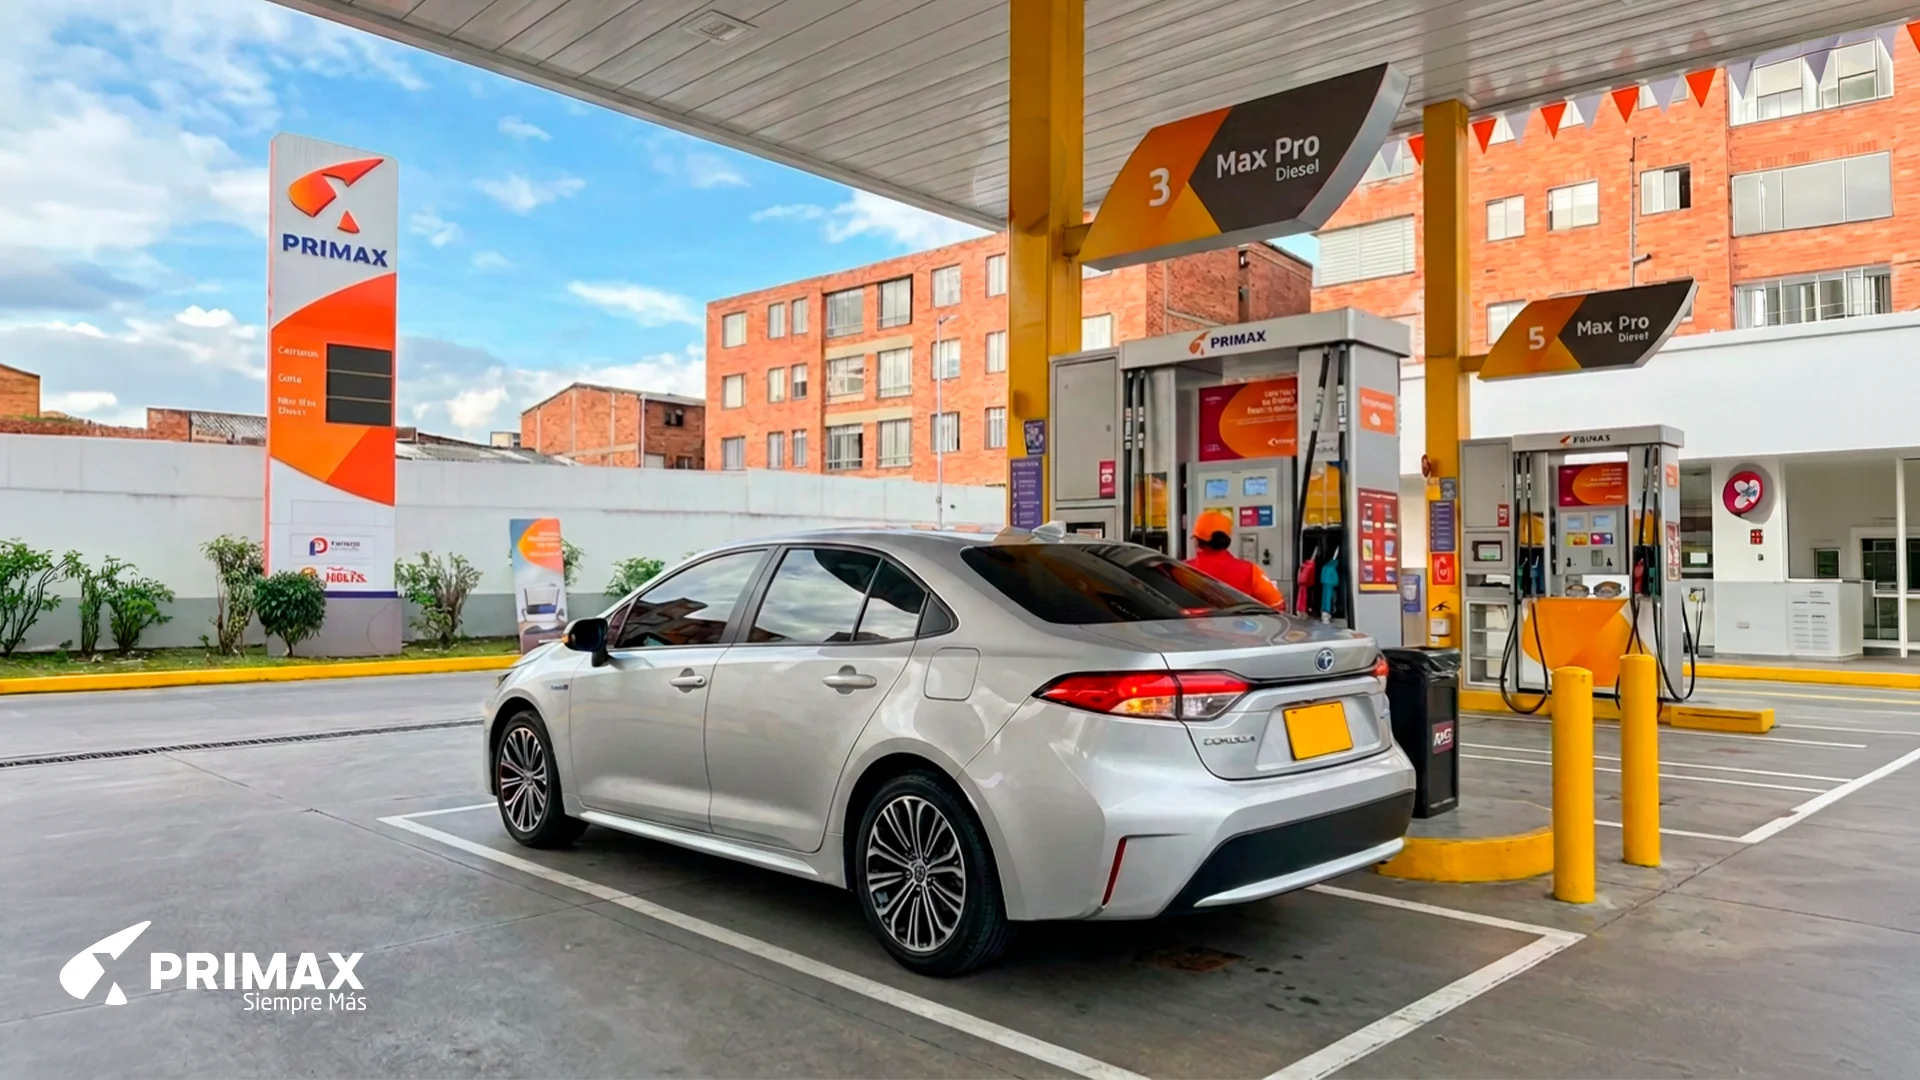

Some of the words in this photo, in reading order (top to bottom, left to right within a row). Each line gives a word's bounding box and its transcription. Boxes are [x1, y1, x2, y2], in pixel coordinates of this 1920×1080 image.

[1216, 148, 1268, 179] Max
[1275, 135, 1320, 164] Pro
[1275, 158, 1320, 182] Diesel
[1149, 167, 1171, 208] 3
[282, 233, 388, 269] PRIMAX
[1528, 326, 1546, 351] 5
[1576, 319, 1614, 337] Max
[1618, 315, 1650, 331] Pro
[1210, 330, 1267, 349] PRIMAX
